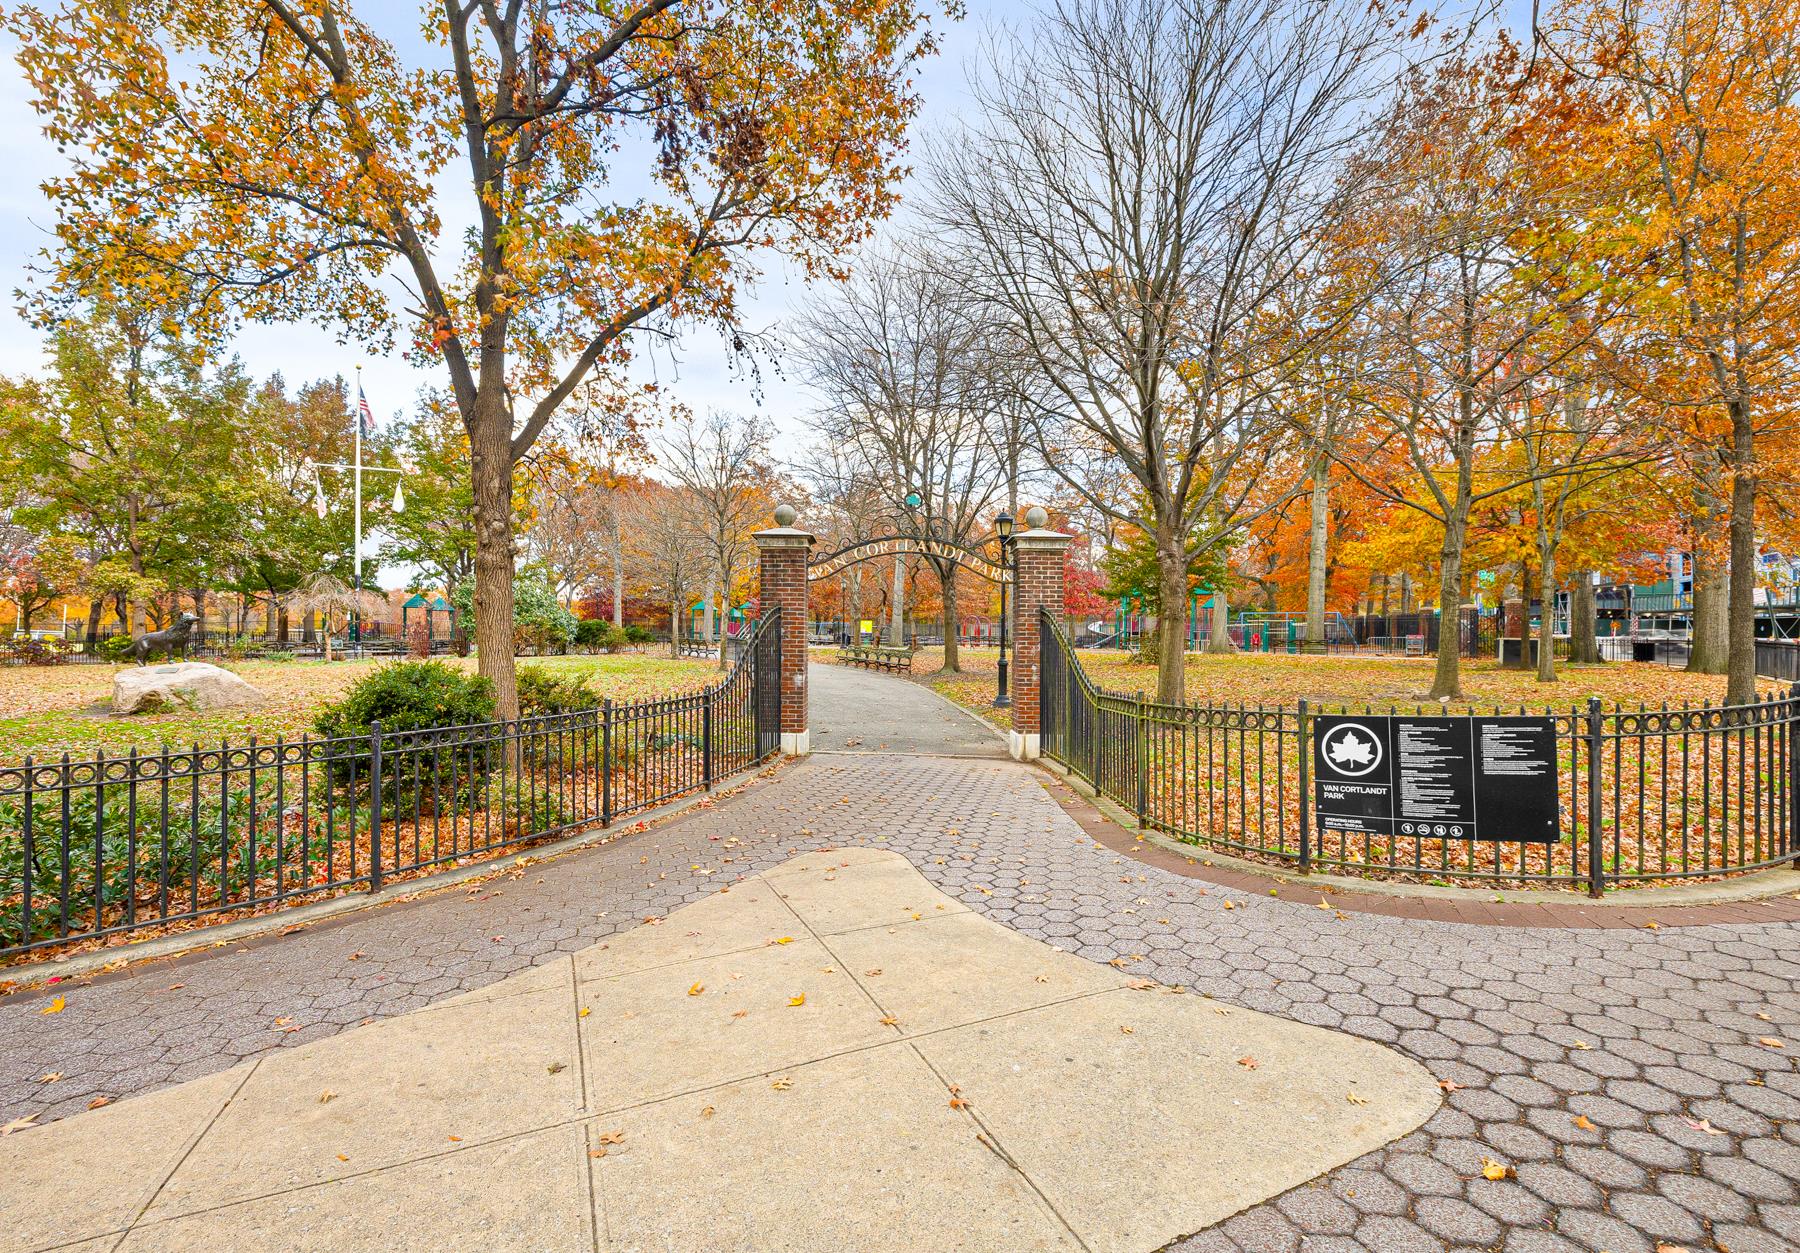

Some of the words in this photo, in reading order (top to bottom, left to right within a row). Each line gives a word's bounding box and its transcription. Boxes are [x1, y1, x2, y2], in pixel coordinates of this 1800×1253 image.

[814, 556, 847, 578] VAN
[854, 539, 968, 564] CORTLANDT
[971, 557, 1013, 582] PARK
[1323, 784, 1339, 792] VAN
[1340, 785, 1388, 795] CORTLANDT
[1324, 791, 1345, 799] PARK
